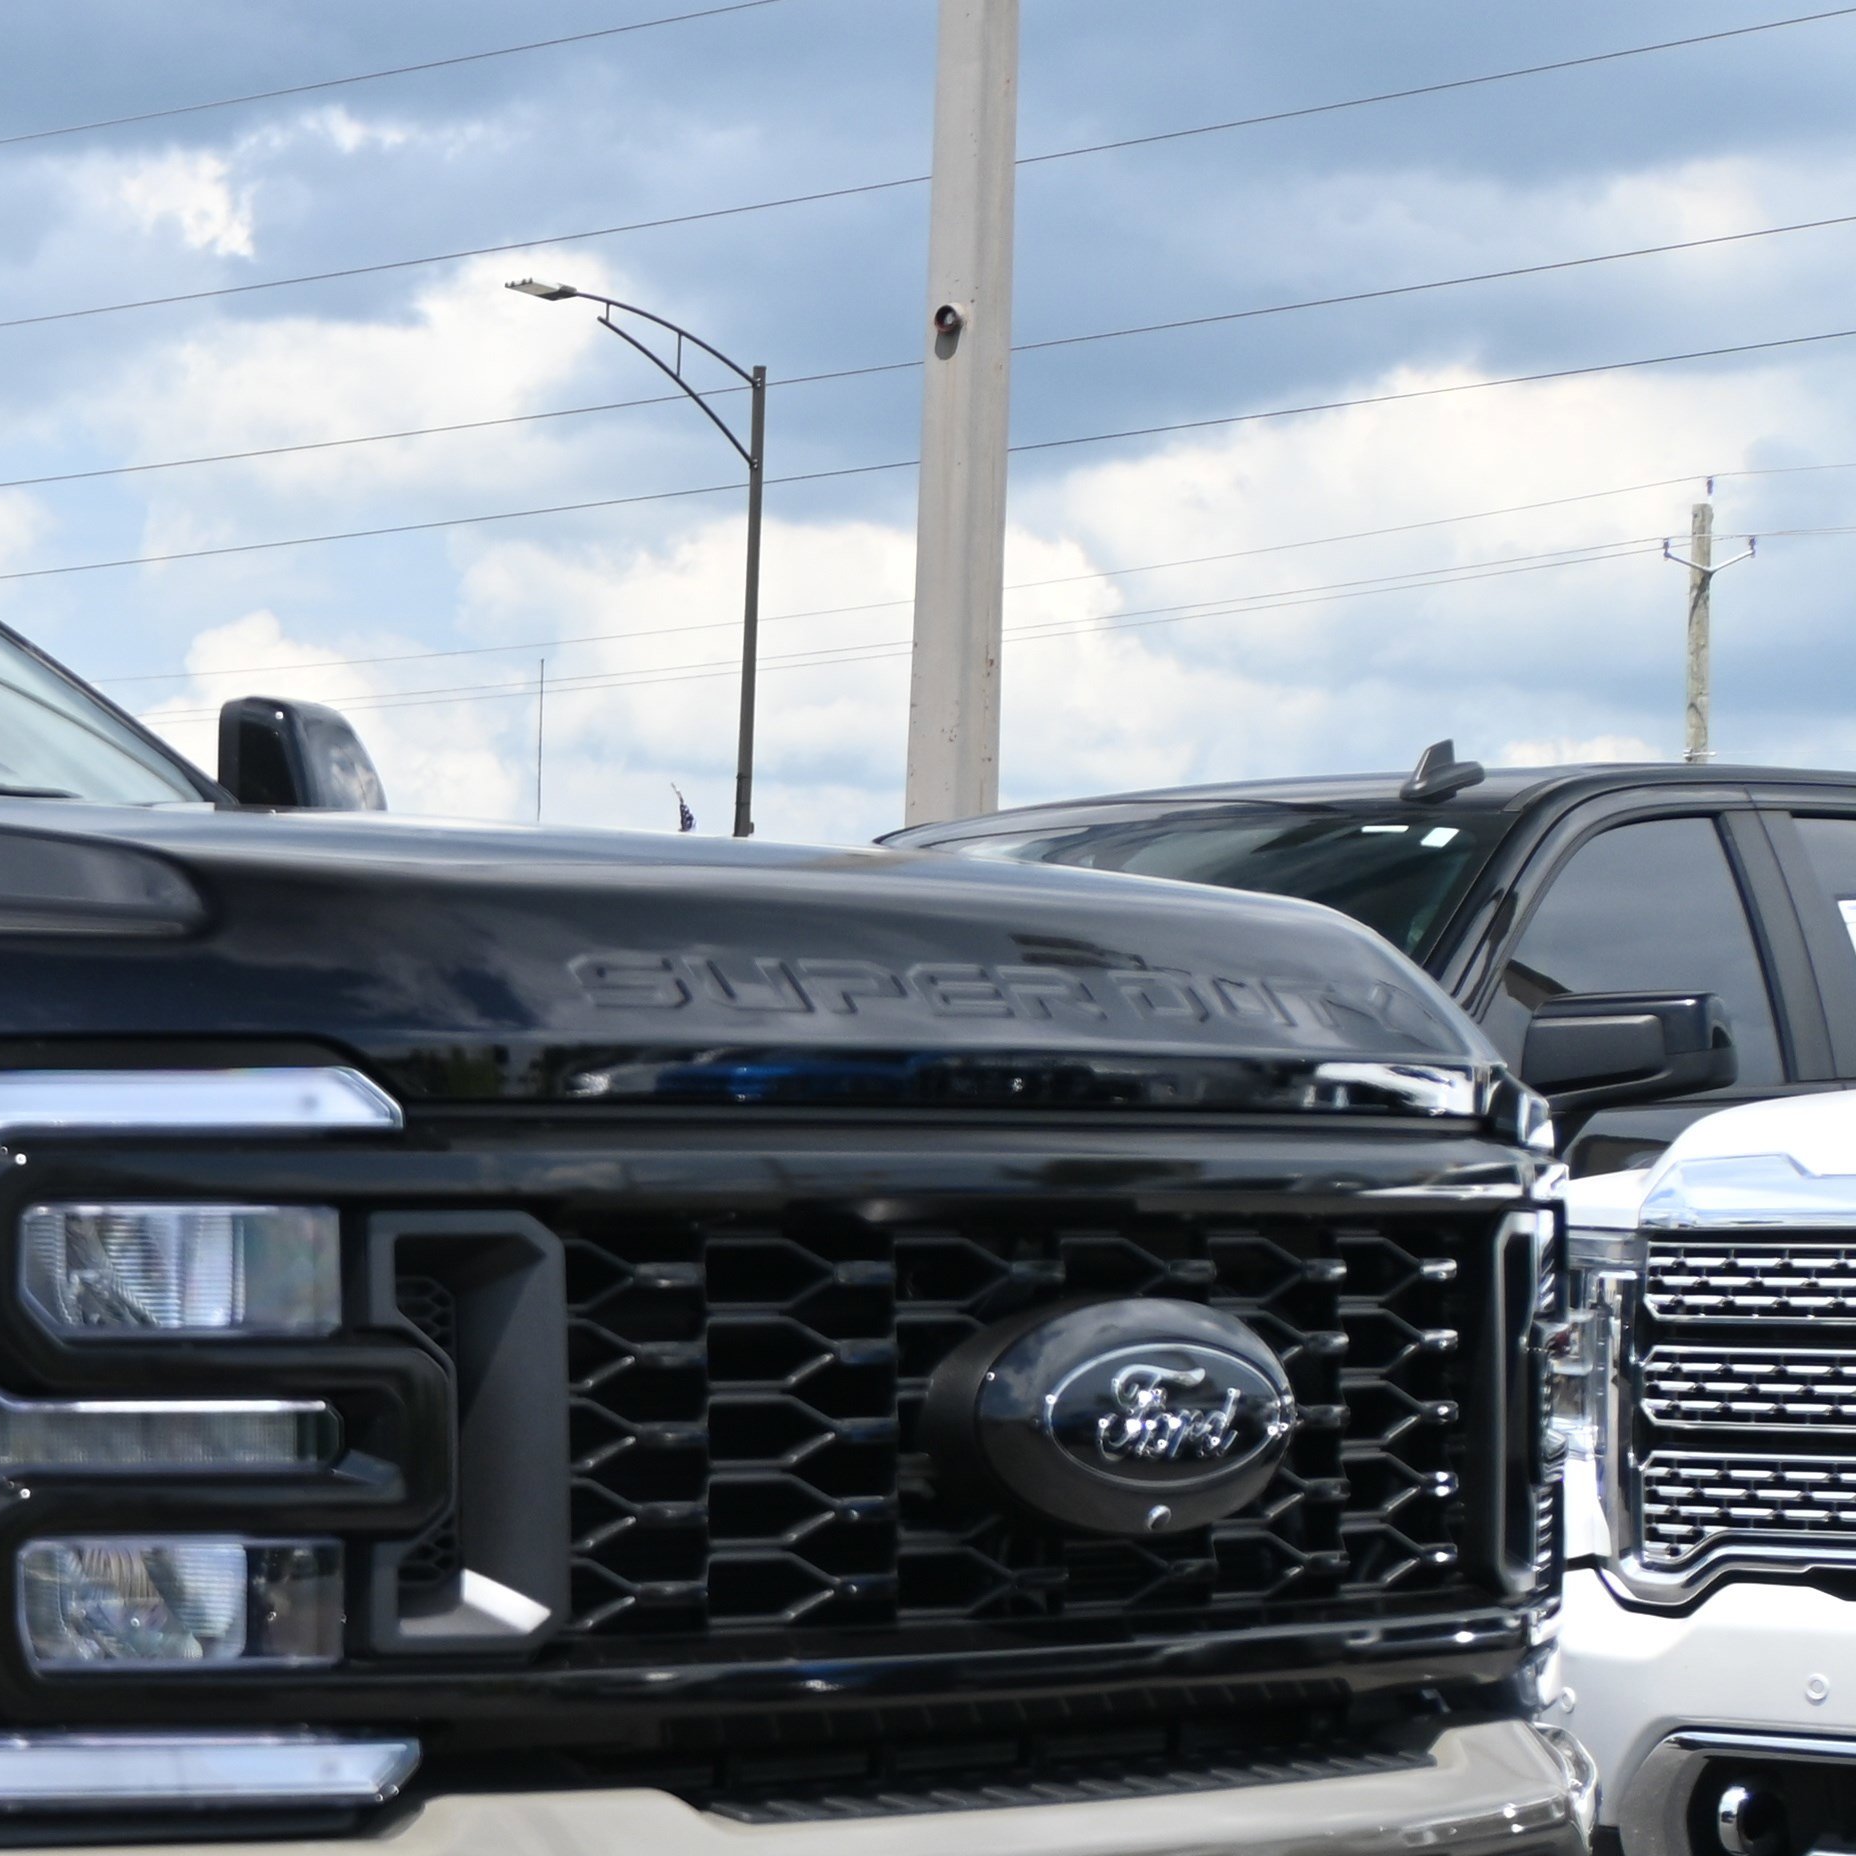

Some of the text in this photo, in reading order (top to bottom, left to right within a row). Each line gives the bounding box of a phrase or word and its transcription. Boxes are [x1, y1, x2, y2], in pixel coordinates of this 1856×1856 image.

[566, 954, 1433, 1034] SUPER DUTY
[1098, 1363, 1240, 1463] Ford
